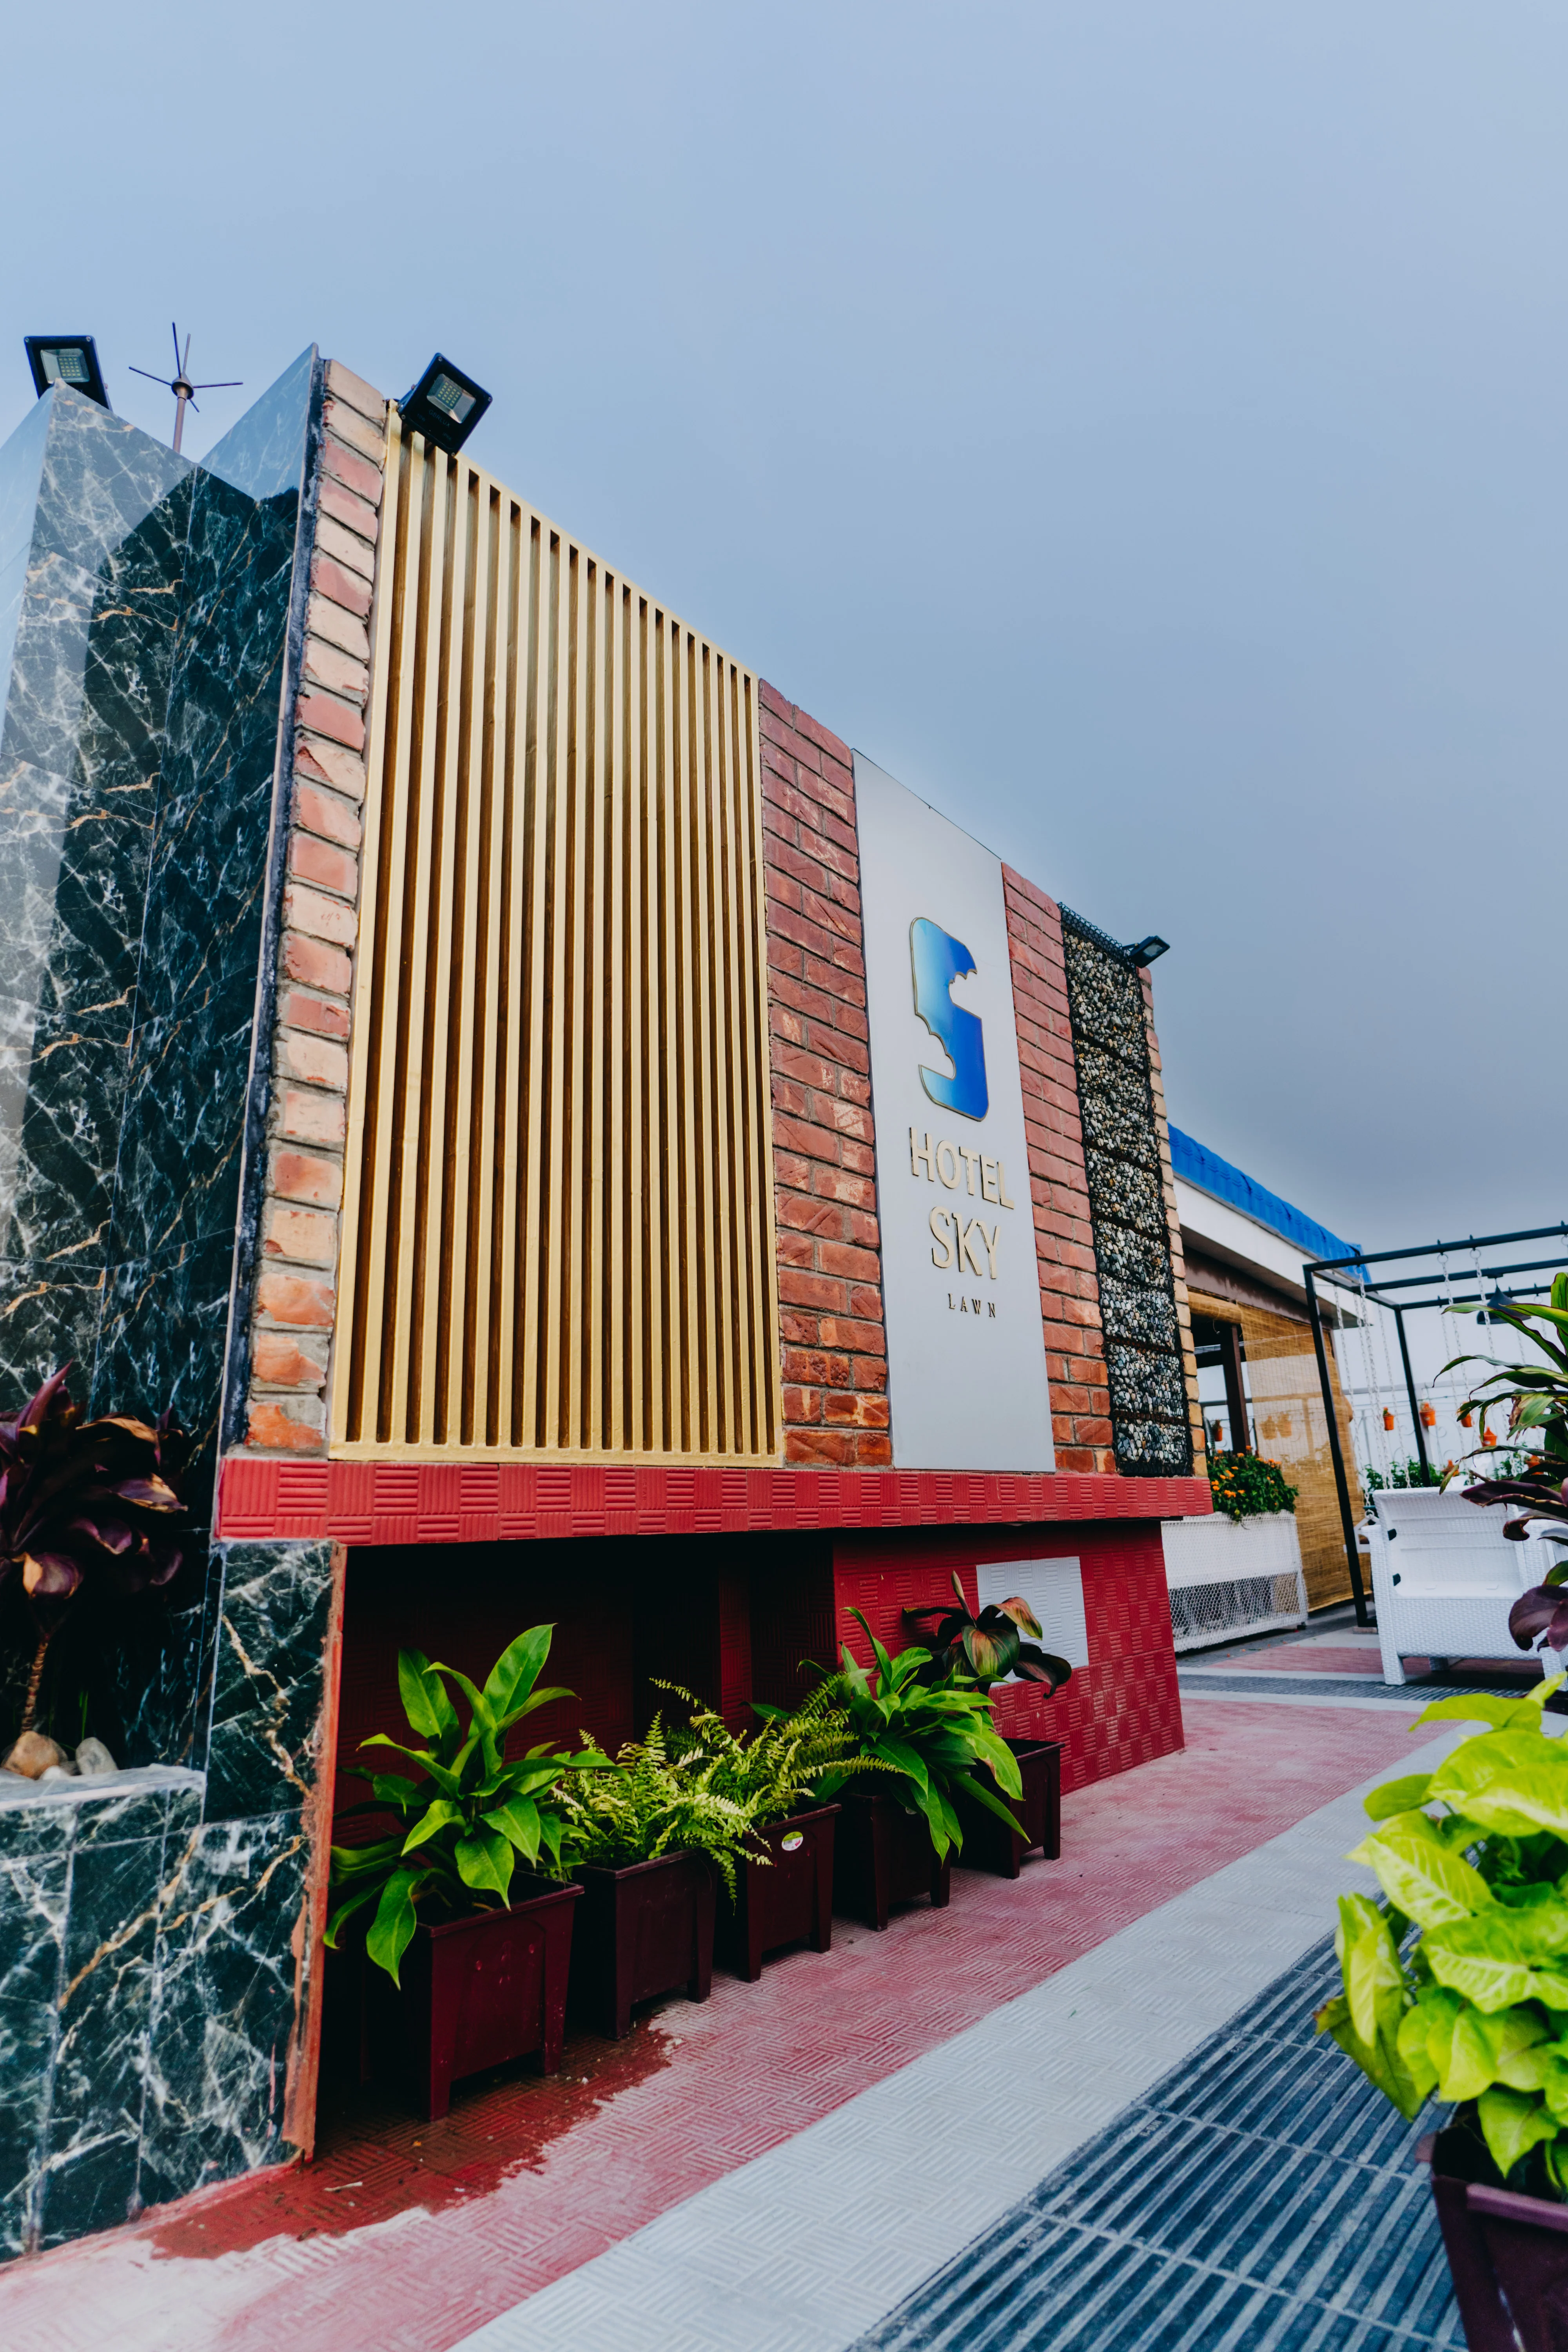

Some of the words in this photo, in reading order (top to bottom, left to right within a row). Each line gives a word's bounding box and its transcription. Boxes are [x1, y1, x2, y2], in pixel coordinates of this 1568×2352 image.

[909, 1127, 1014, 1209] HOTEL
[929, 1206, 1001, 1279] SKY
[948, 1293, 996, 1318] LAWN
